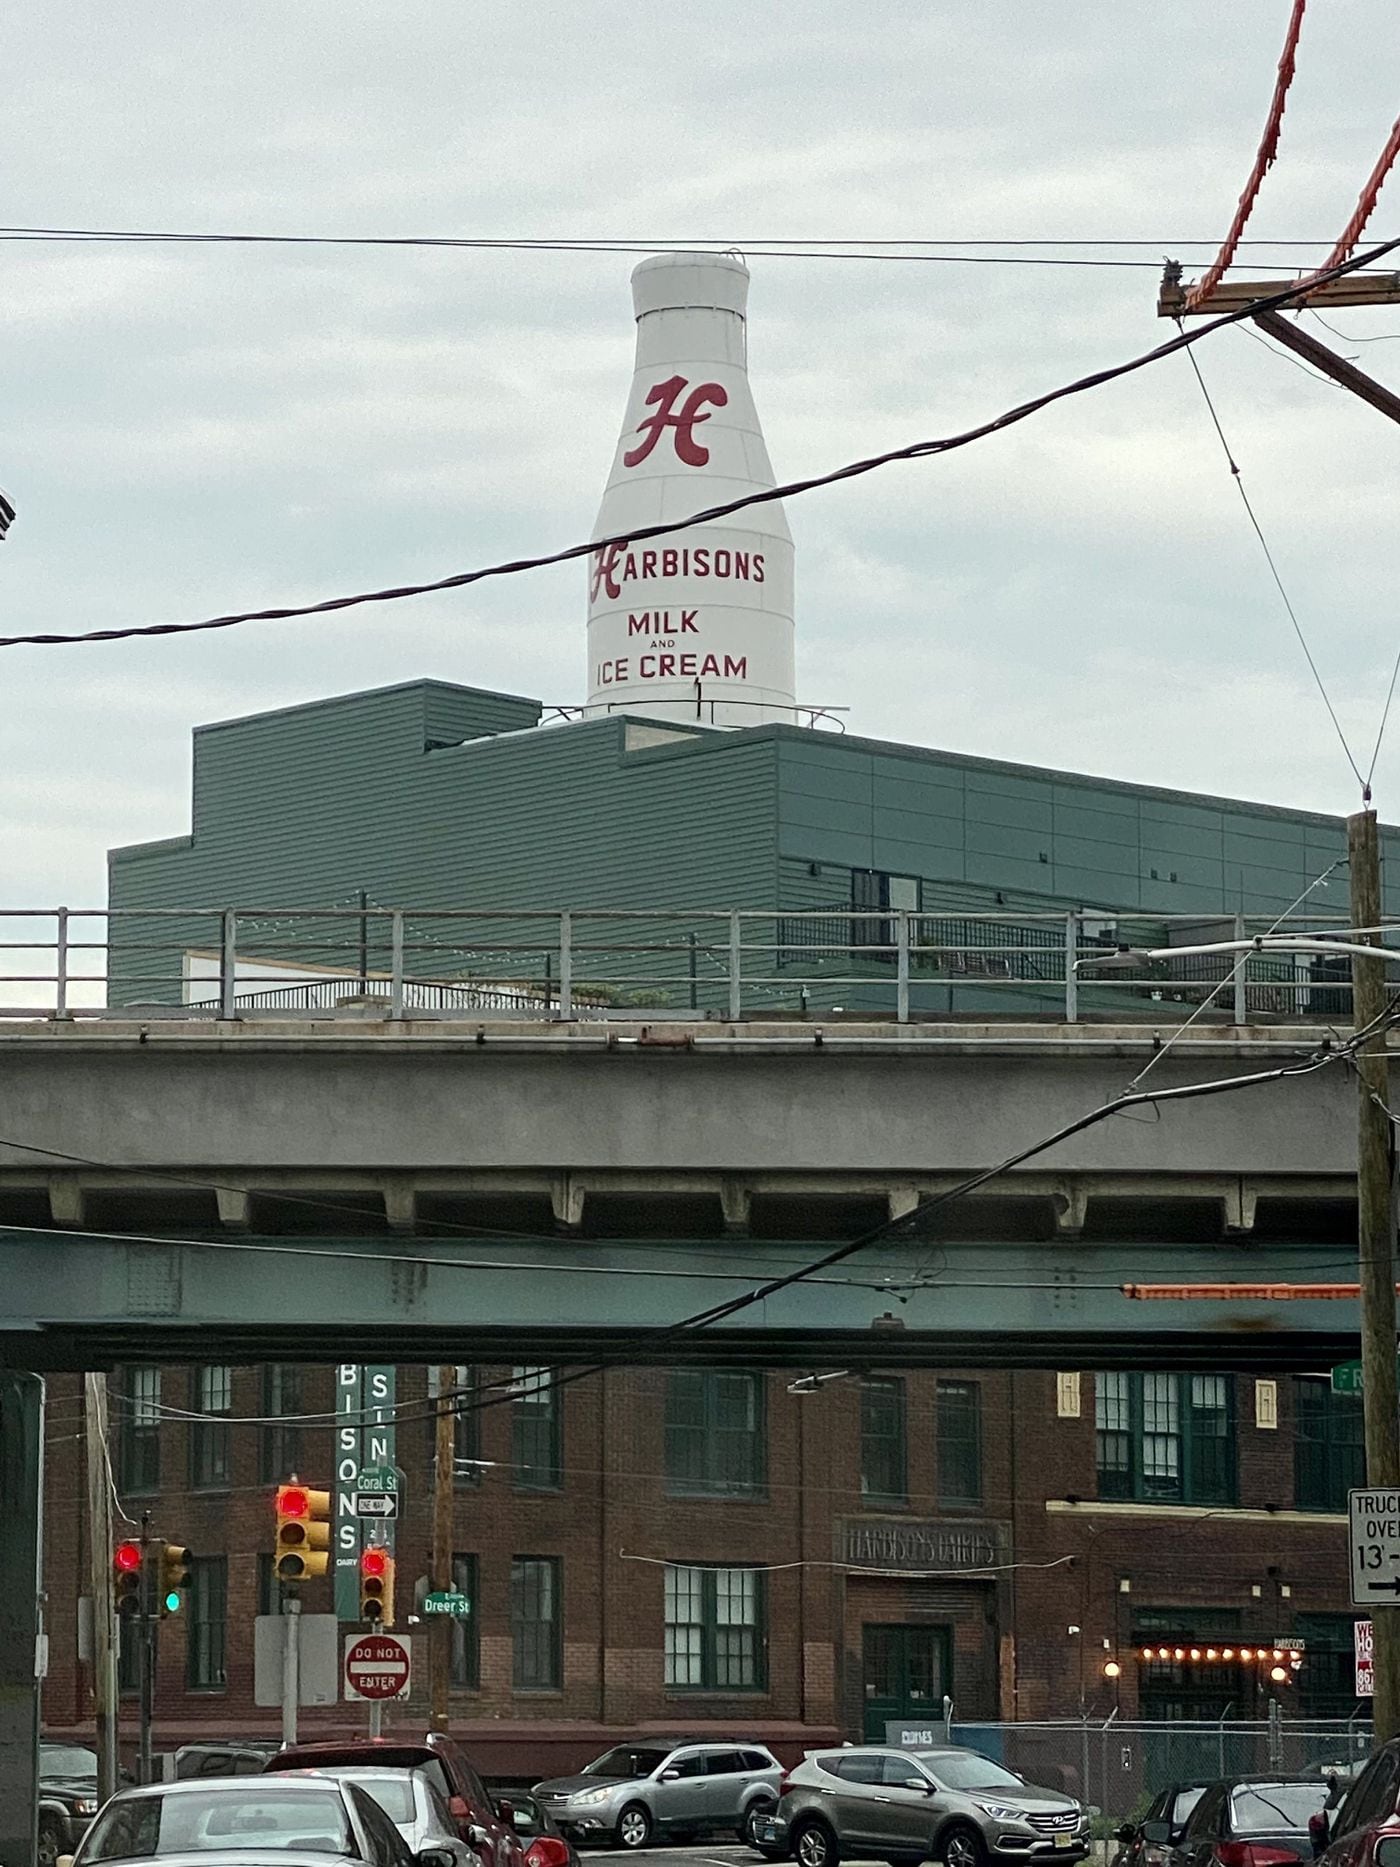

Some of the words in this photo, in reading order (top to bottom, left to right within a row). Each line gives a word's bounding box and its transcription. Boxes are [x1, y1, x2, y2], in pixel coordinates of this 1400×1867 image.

[591, 539, 765, 604] HARBISONS
[628, 610, 699, 636] MILK
[650, 639, 675, 648] AND
[597, 658, 628, 686] ICE
[639, 653, 747, 679] CREAM
[357, 1475, 383, 1490] Coral
[386, 1476, 397, 1490] St
[1356, 1495, 1400, 1514] TRUC
[1367, 1520, 1400, 1538] OVE
[424, 1599, 456, 1612] Dreer
[458, 1601, 470, 1614] St
[355, 1648, 372, 1659] DO
[376, 1648, 401, 1659] NOT
[359, 1676, 396, 1688] ENTER
